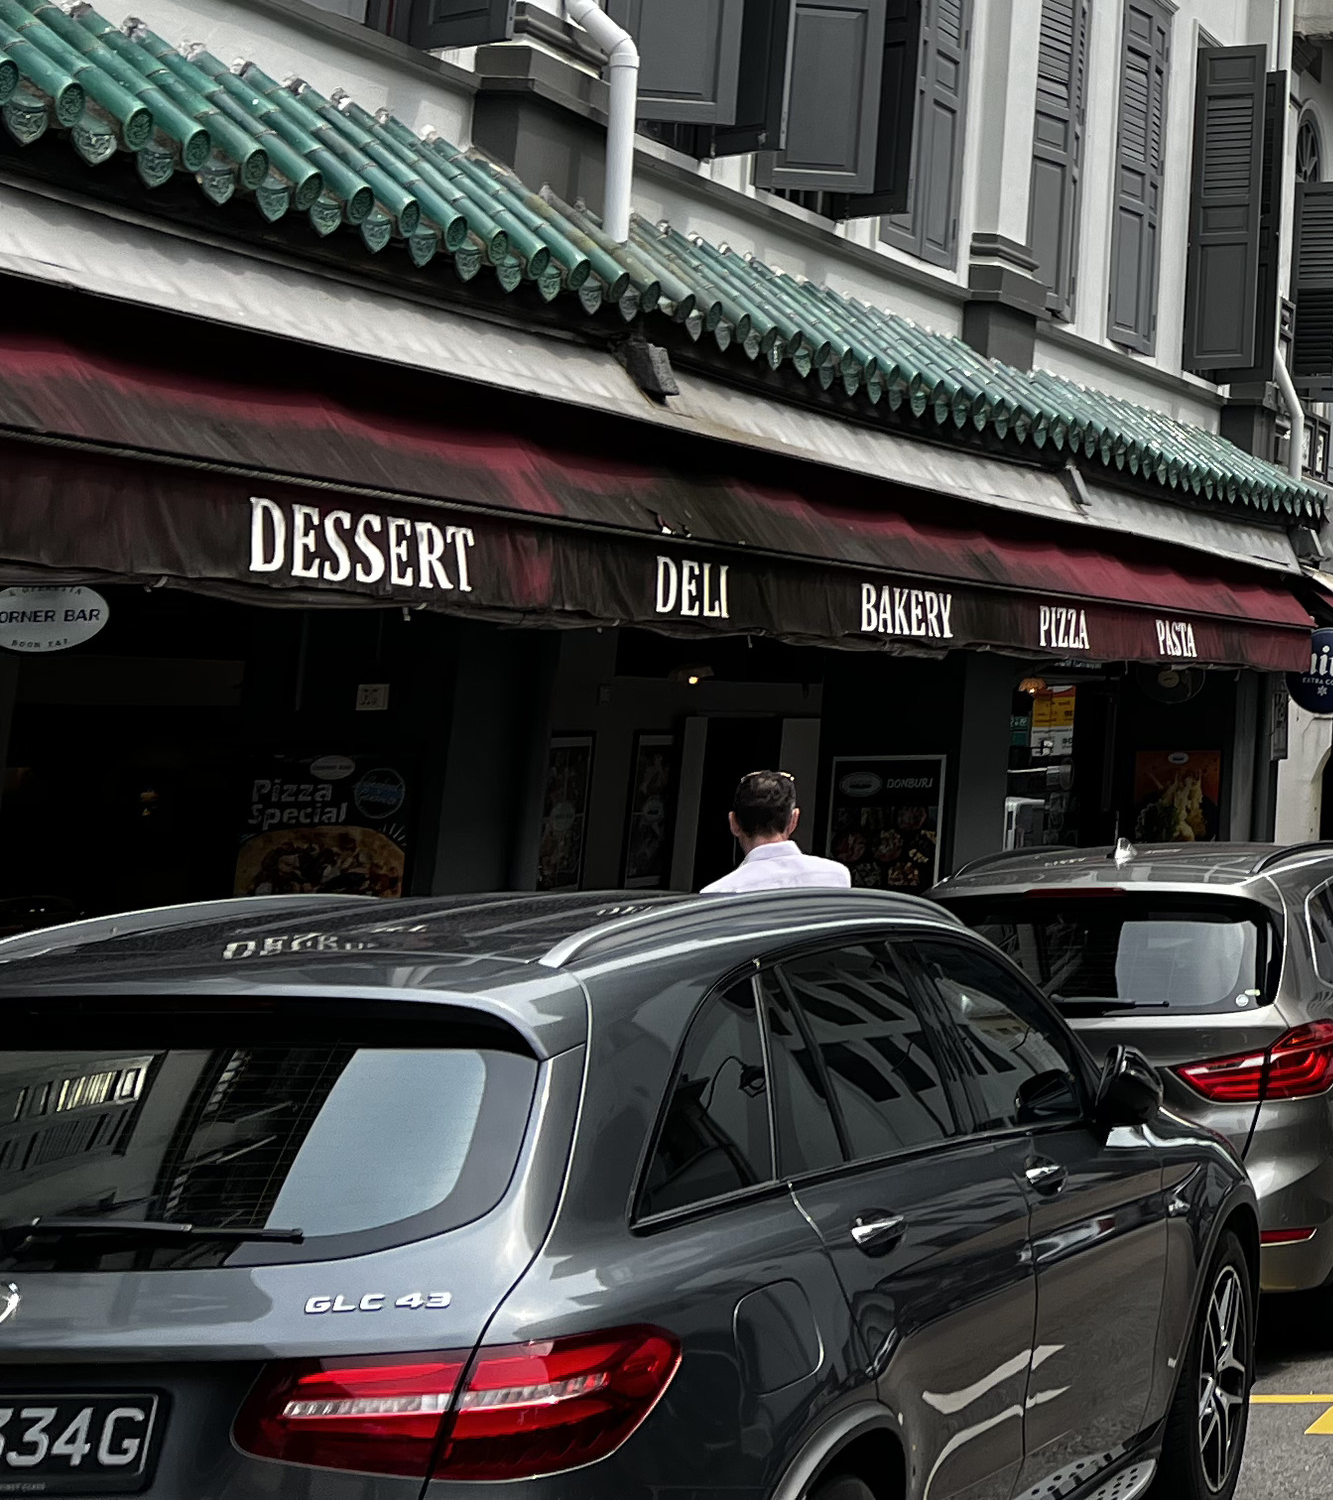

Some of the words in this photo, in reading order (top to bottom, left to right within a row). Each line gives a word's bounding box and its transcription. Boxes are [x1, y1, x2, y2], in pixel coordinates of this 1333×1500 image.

[249, 497, 475, 592] DESSERT
[655, 555, 730, 619] DELI
[0, 609, 56, 623] ORNER
[63, 608, 101, 622] BAR
[861, 582, 953, 639] BAKERY
[1039, 605, 1090, 650] PIZZA
[1155, 619, 1198, 658] PASTA
[1302, 677, 1324, 685] EXTRA
[251, 778, 334, 802] Pizza
[886, 777, 934, 789] DONBURI
[247, 802, 348, 831] Special
[304, 1293, 386, 1315] GLC
[394, 1291, 452, 1310] 43
